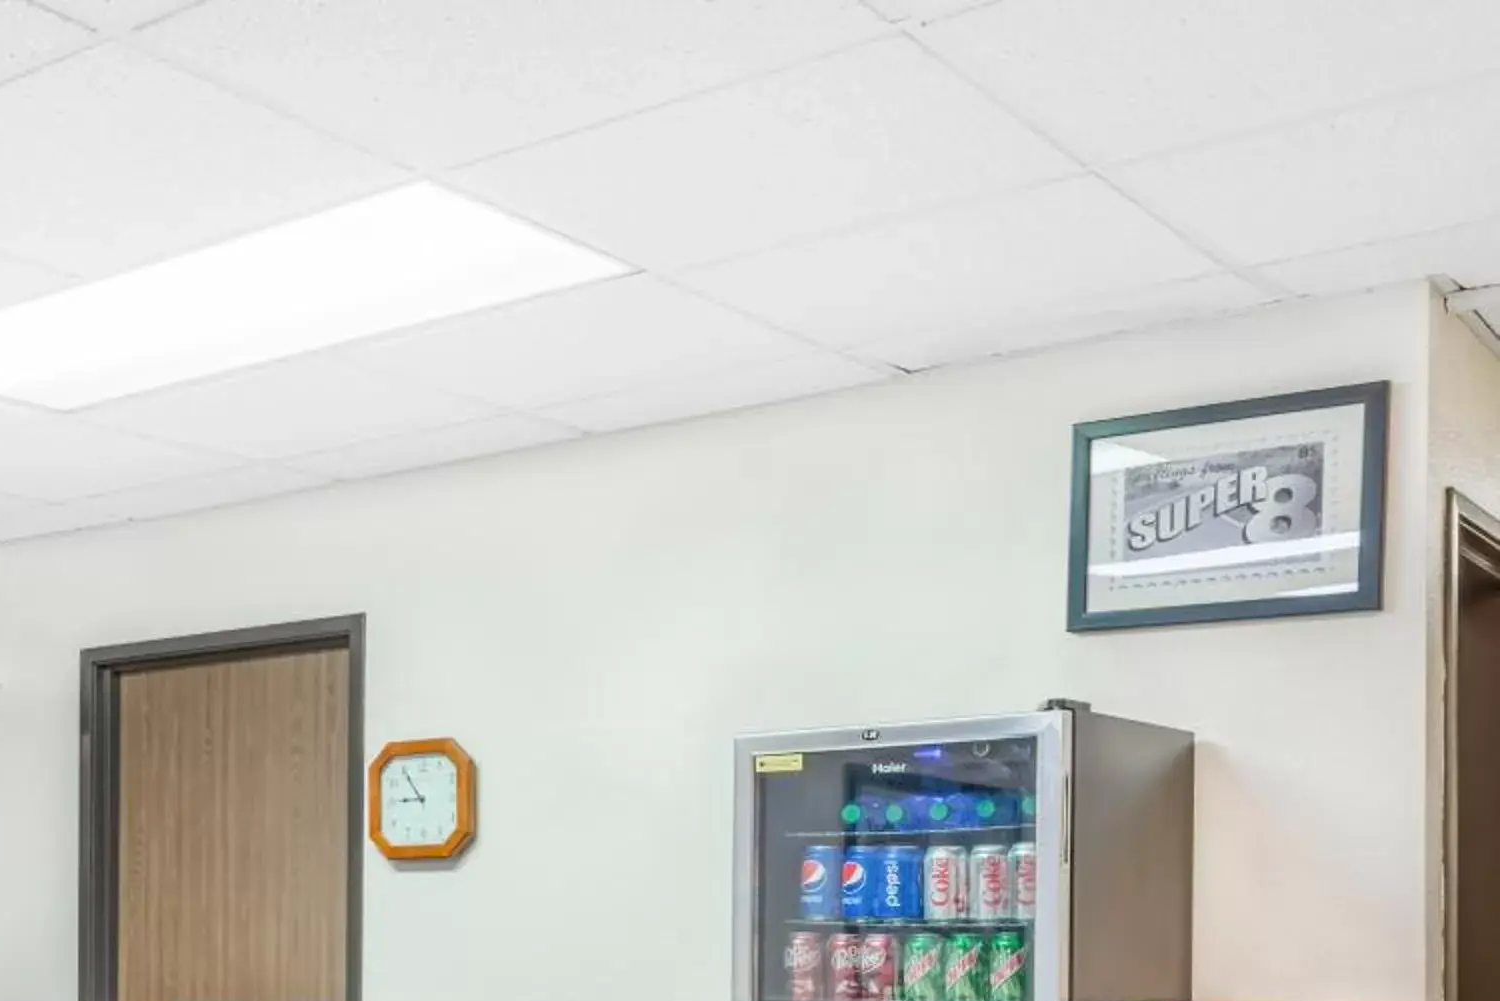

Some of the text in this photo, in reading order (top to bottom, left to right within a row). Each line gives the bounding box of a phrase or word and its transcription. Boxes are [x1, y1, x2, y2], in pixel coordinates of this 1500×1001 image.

[1128, 466, 1317, 551] SUPER 8
[871, 762, 907, 774] Haier
[884, 860, 901, 907] pepsi
[932, 858, 949, 906] Coke
[984, 855, 1001, 907] Coke
